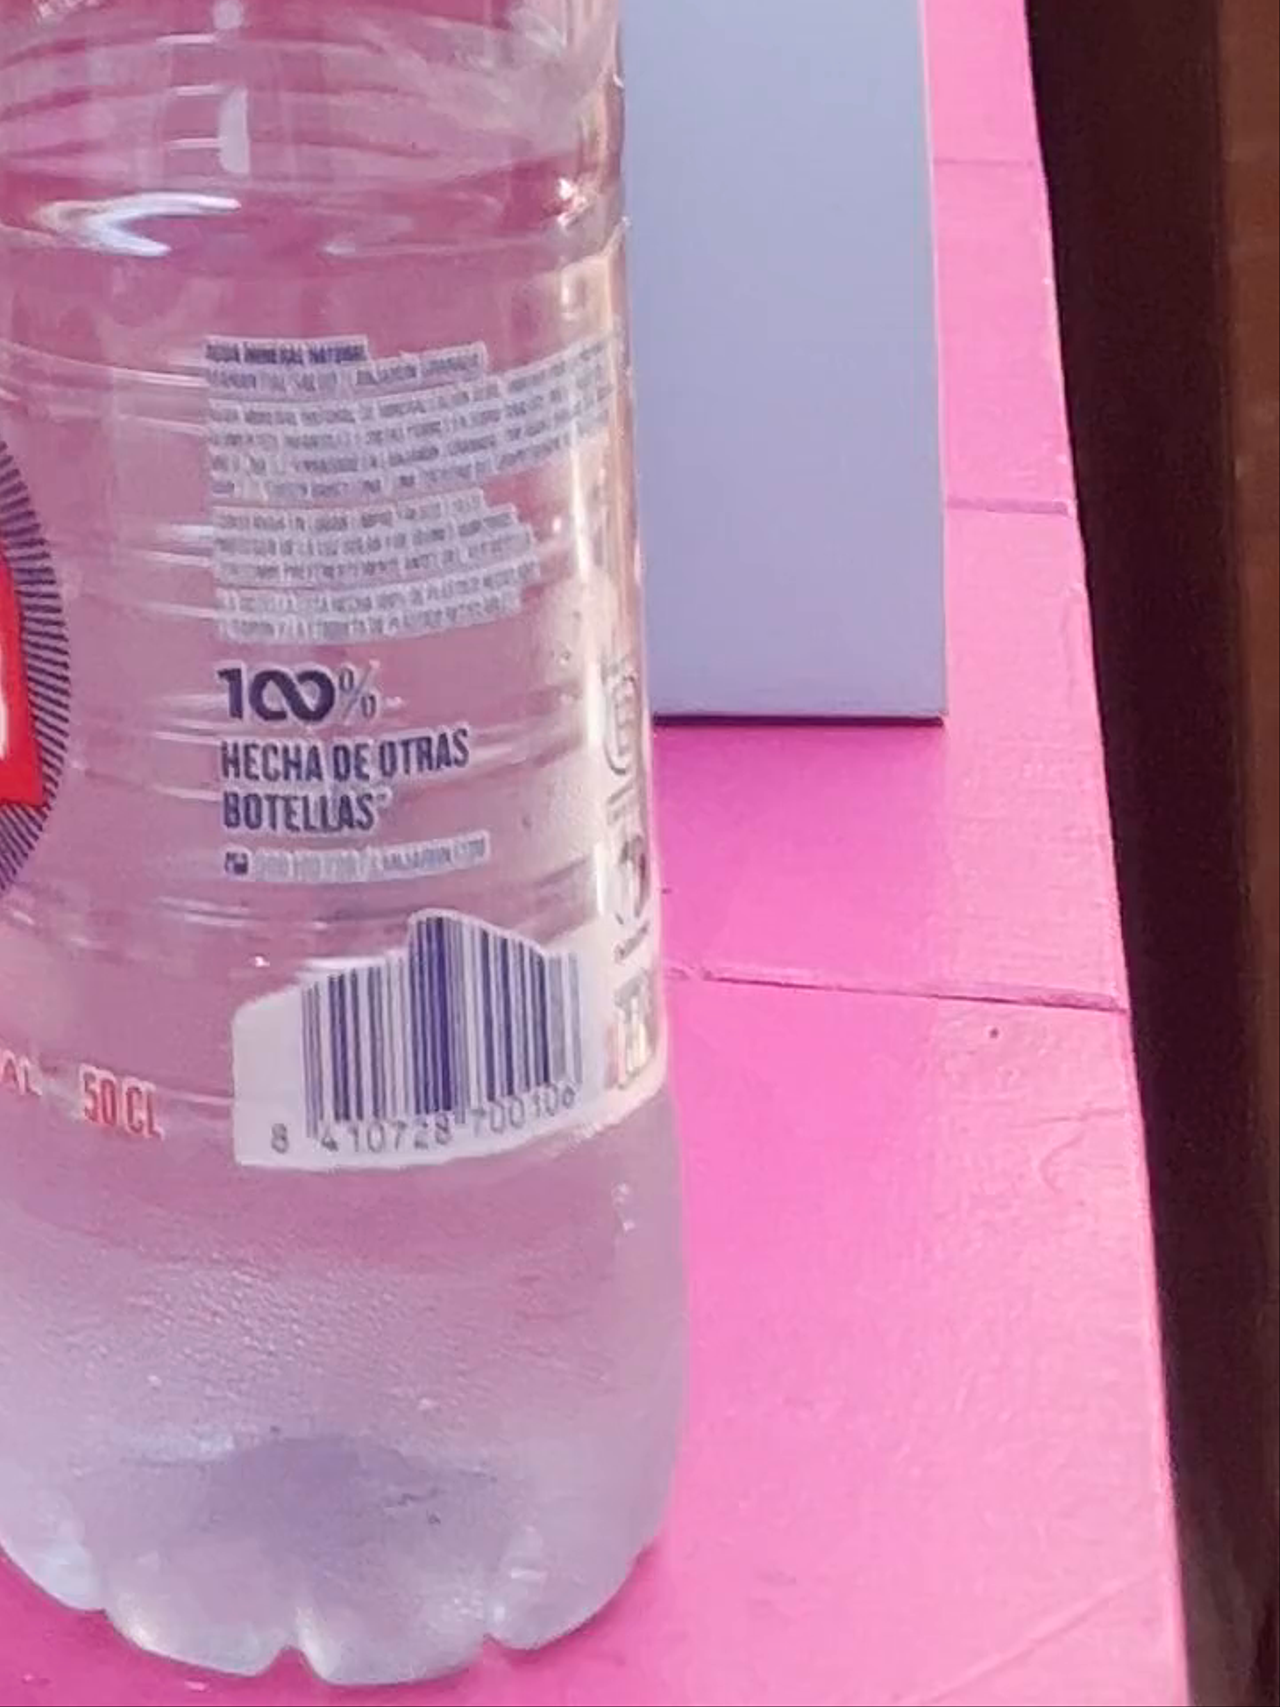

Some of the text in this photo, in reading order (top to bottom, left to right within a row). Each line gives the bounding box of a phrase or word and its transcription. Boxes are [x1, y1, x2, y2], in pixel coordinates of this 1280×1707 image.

[218, 667, 377, 722] 100%
[220, 728, 470, 782] HECHA DE OTRAS
[270, 1123, 290, 1154] 8
